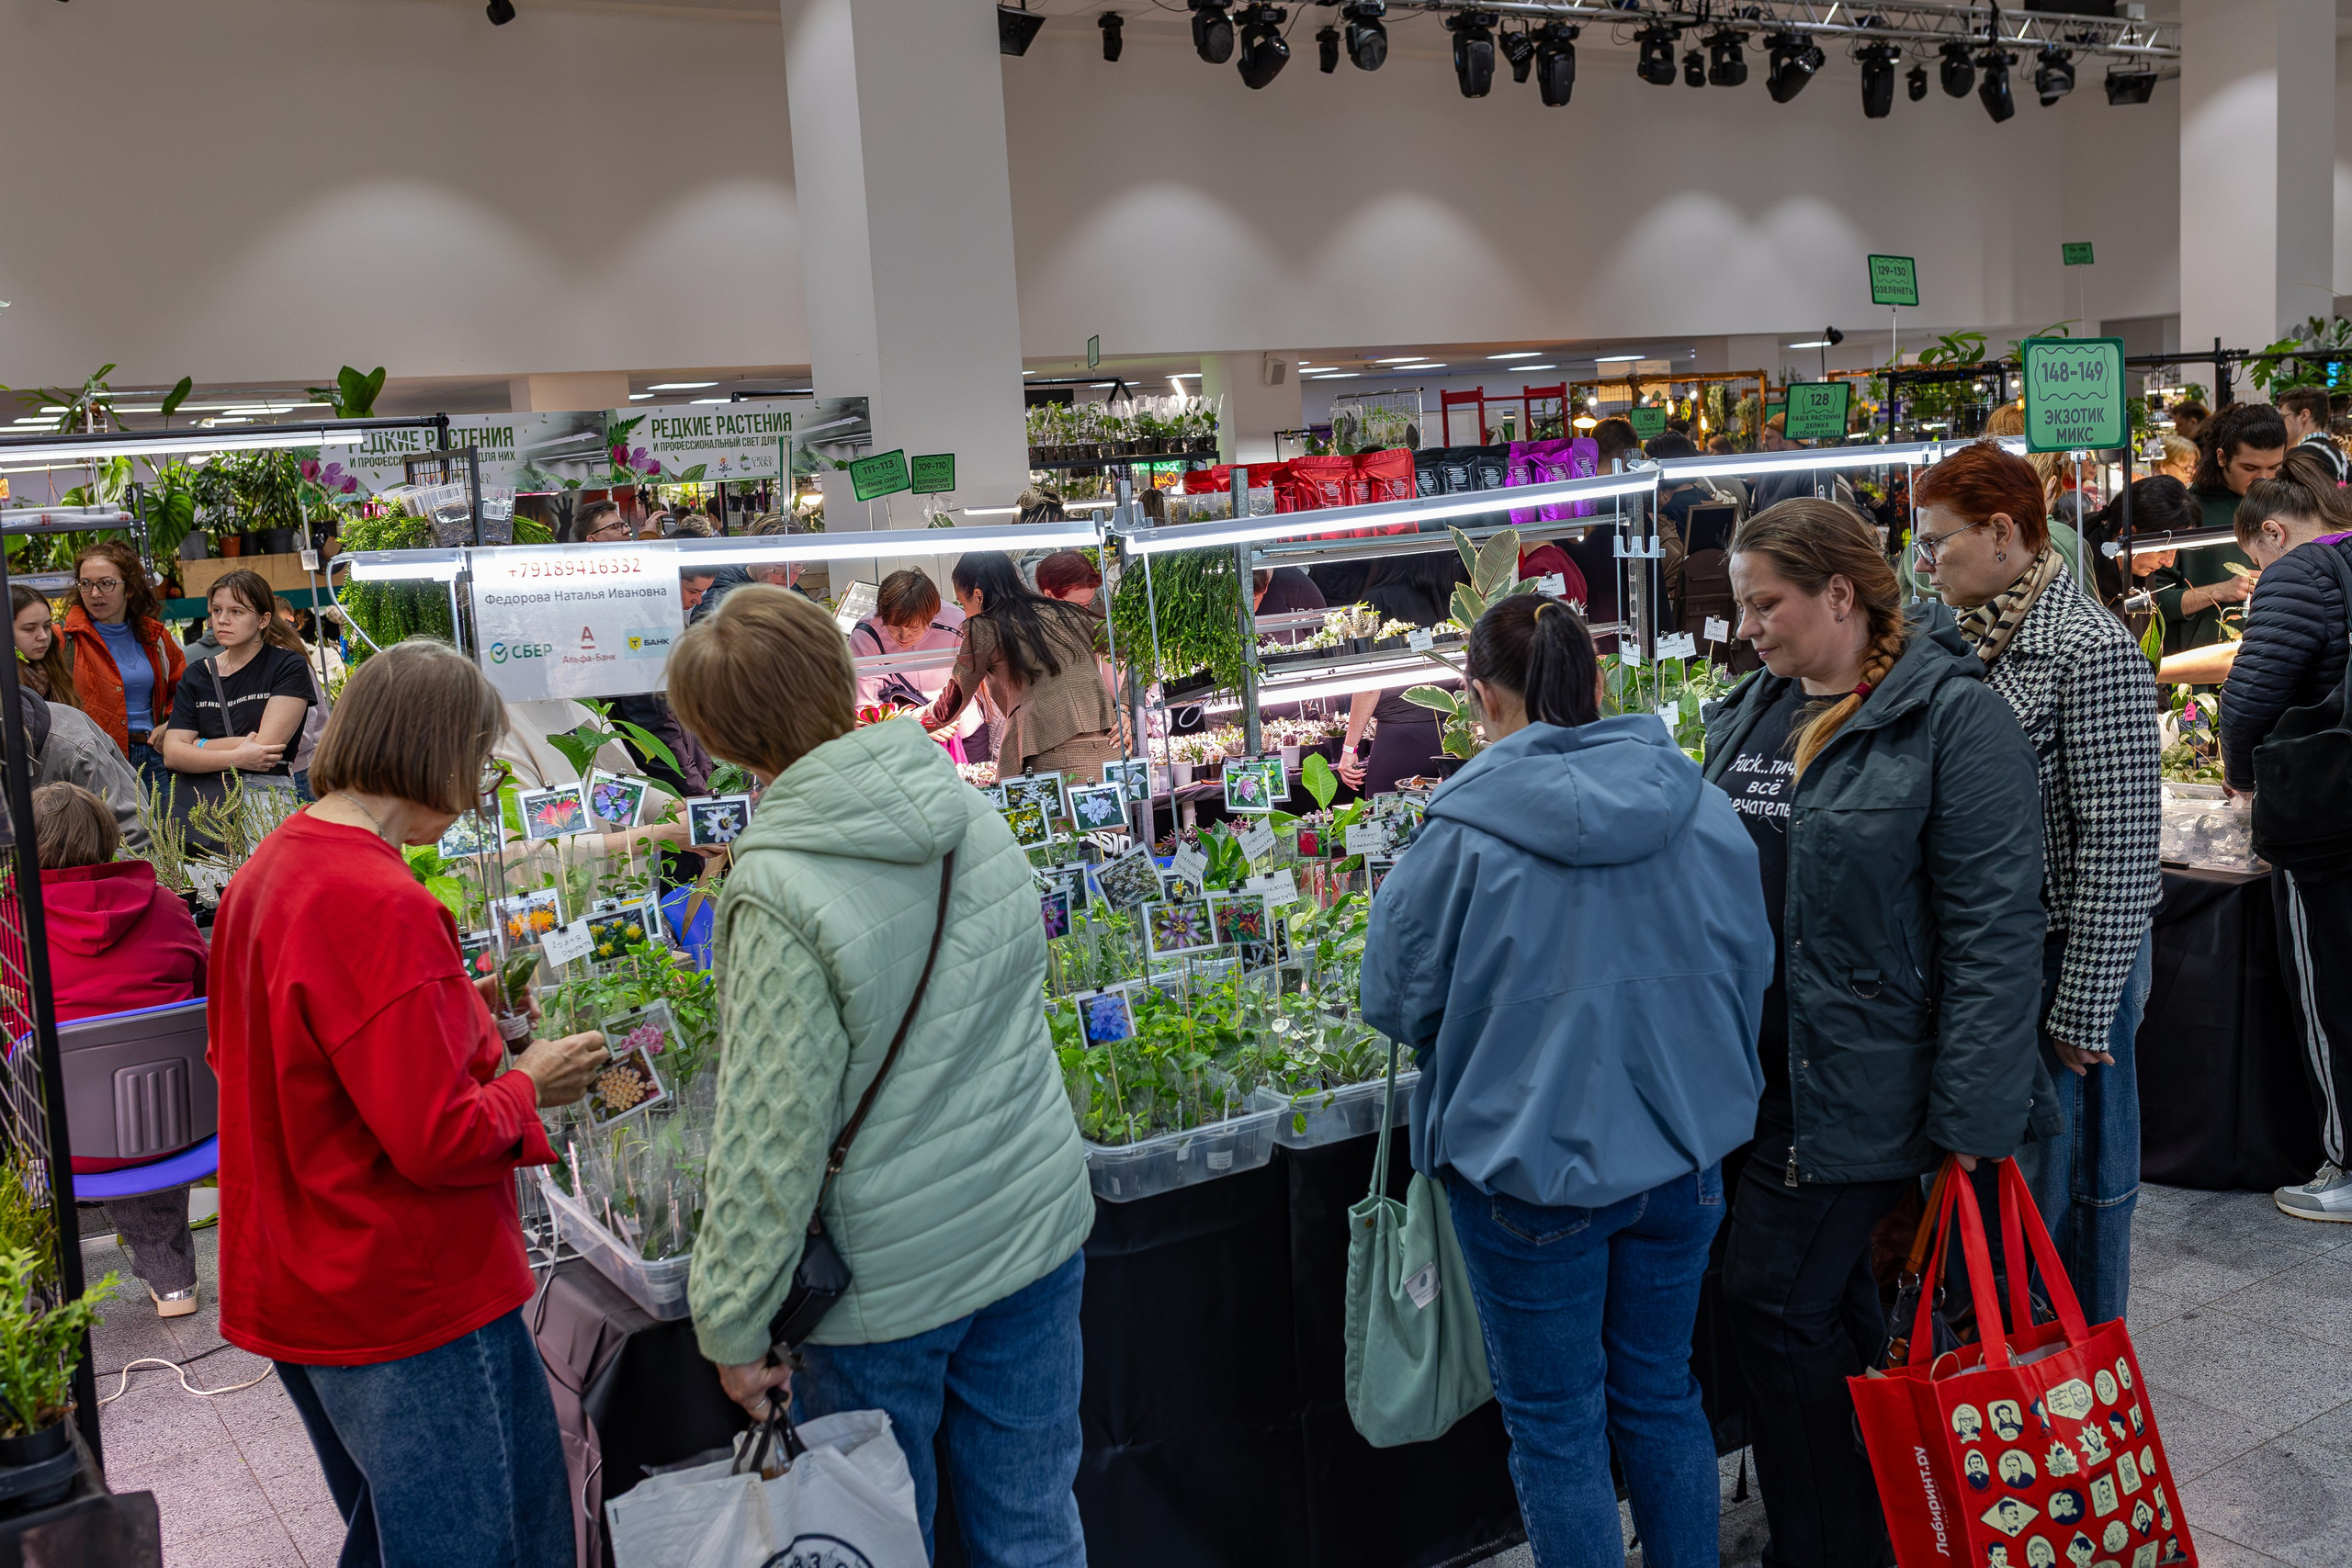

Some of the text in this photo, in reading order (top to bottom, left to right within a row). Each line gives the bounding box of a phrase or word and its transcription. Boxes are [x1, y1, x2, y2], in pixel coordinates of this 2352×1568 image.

[1877, 265, 1906, 276] 129-130
[2041, 361, 2104, 383] 148-149
[1810, 393, 1829, 406] 128
[1643, 413, 1656, 422] 108
[2044, 407, 2105, 425] ЭКЗОТИК
[650, 412, 792, 440] РЕДКИЕ РАСТЕНИЯ
[424, 426, 514, 452] РСТЕНИЯ
[652, 442, 660, 452] И
[660, 437, 741, 452] ПРОФЕССИОНАЛЬНЫЙ
[741, 436, 760, 446] СВЕТ
[761, 435, 777, 447] ДЛЯ
[2056, 426, 2094, 444] МИКС
[498, 451, 516, 461] НИХ
[862, 459, 895, 475] 111-113
[918, 461, 947, 471] 109-110
[884, 474, 904, 483] ОЗЕРО
[508, 558, 642, 579] +79189416332
[485, 586, 667, 606] Федорова Наталья Ивановна
[644, 637, 670, 647] БАНК
[512, 643, 553, 660] СБЕР
[562, 653, 616, 664] Альфа-Банк
[1746, 779, 1784, 795] всё
[1728, 797, 1791, 817] ечатель
[1914, 1446, 1951, 1557] Лабиринт.ру
